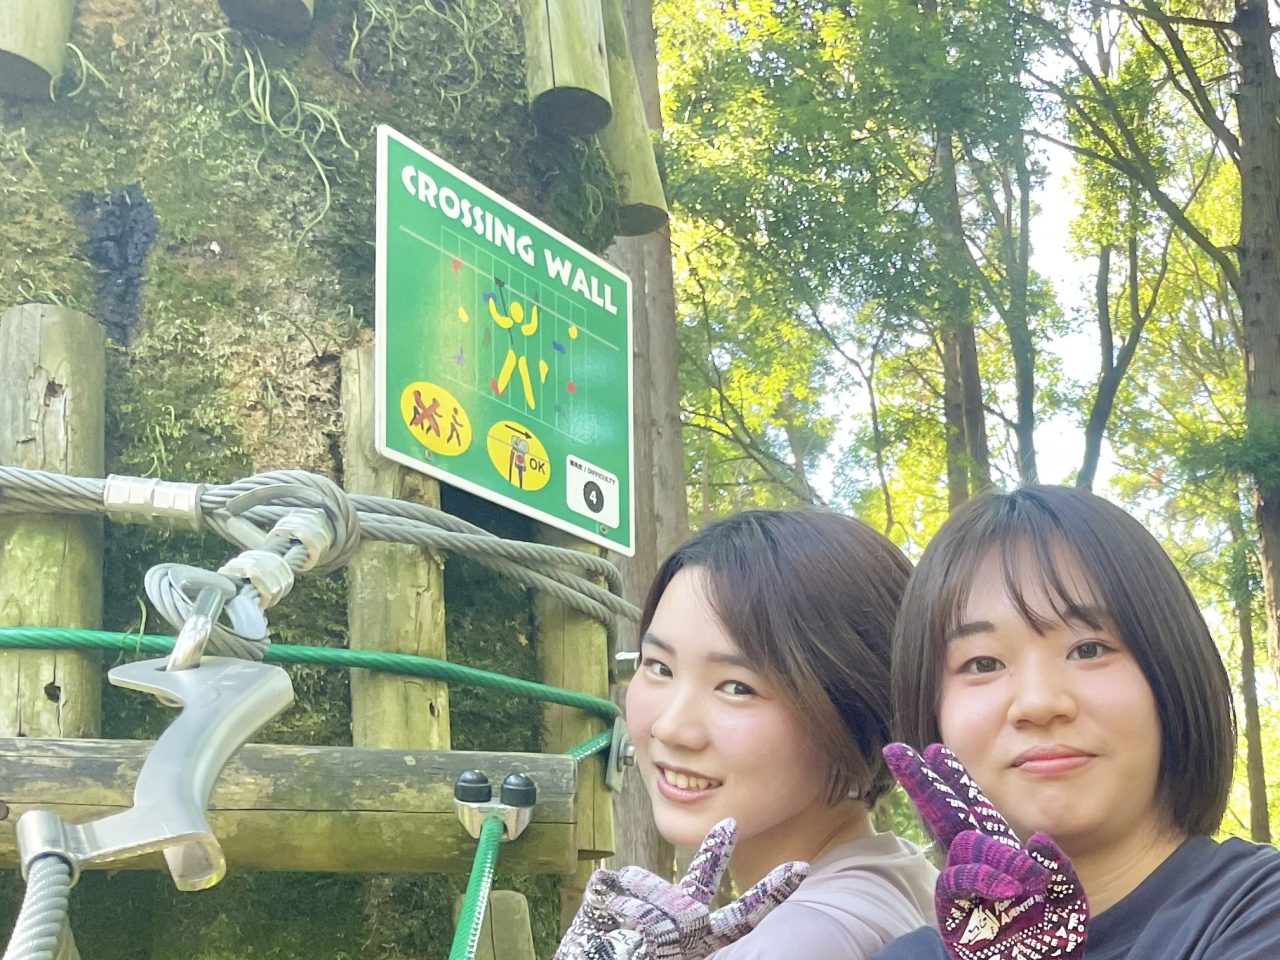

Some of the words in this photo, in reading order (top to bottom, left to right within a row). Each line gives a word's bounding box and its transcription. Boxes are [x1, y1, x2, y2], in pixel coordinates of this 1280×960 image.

[401, 165, 535, 267] CROSSING
[543, 248, 618, 316] WALL
[529, 457, 546, 475] OK
[589, 490, 598, 505] 4
